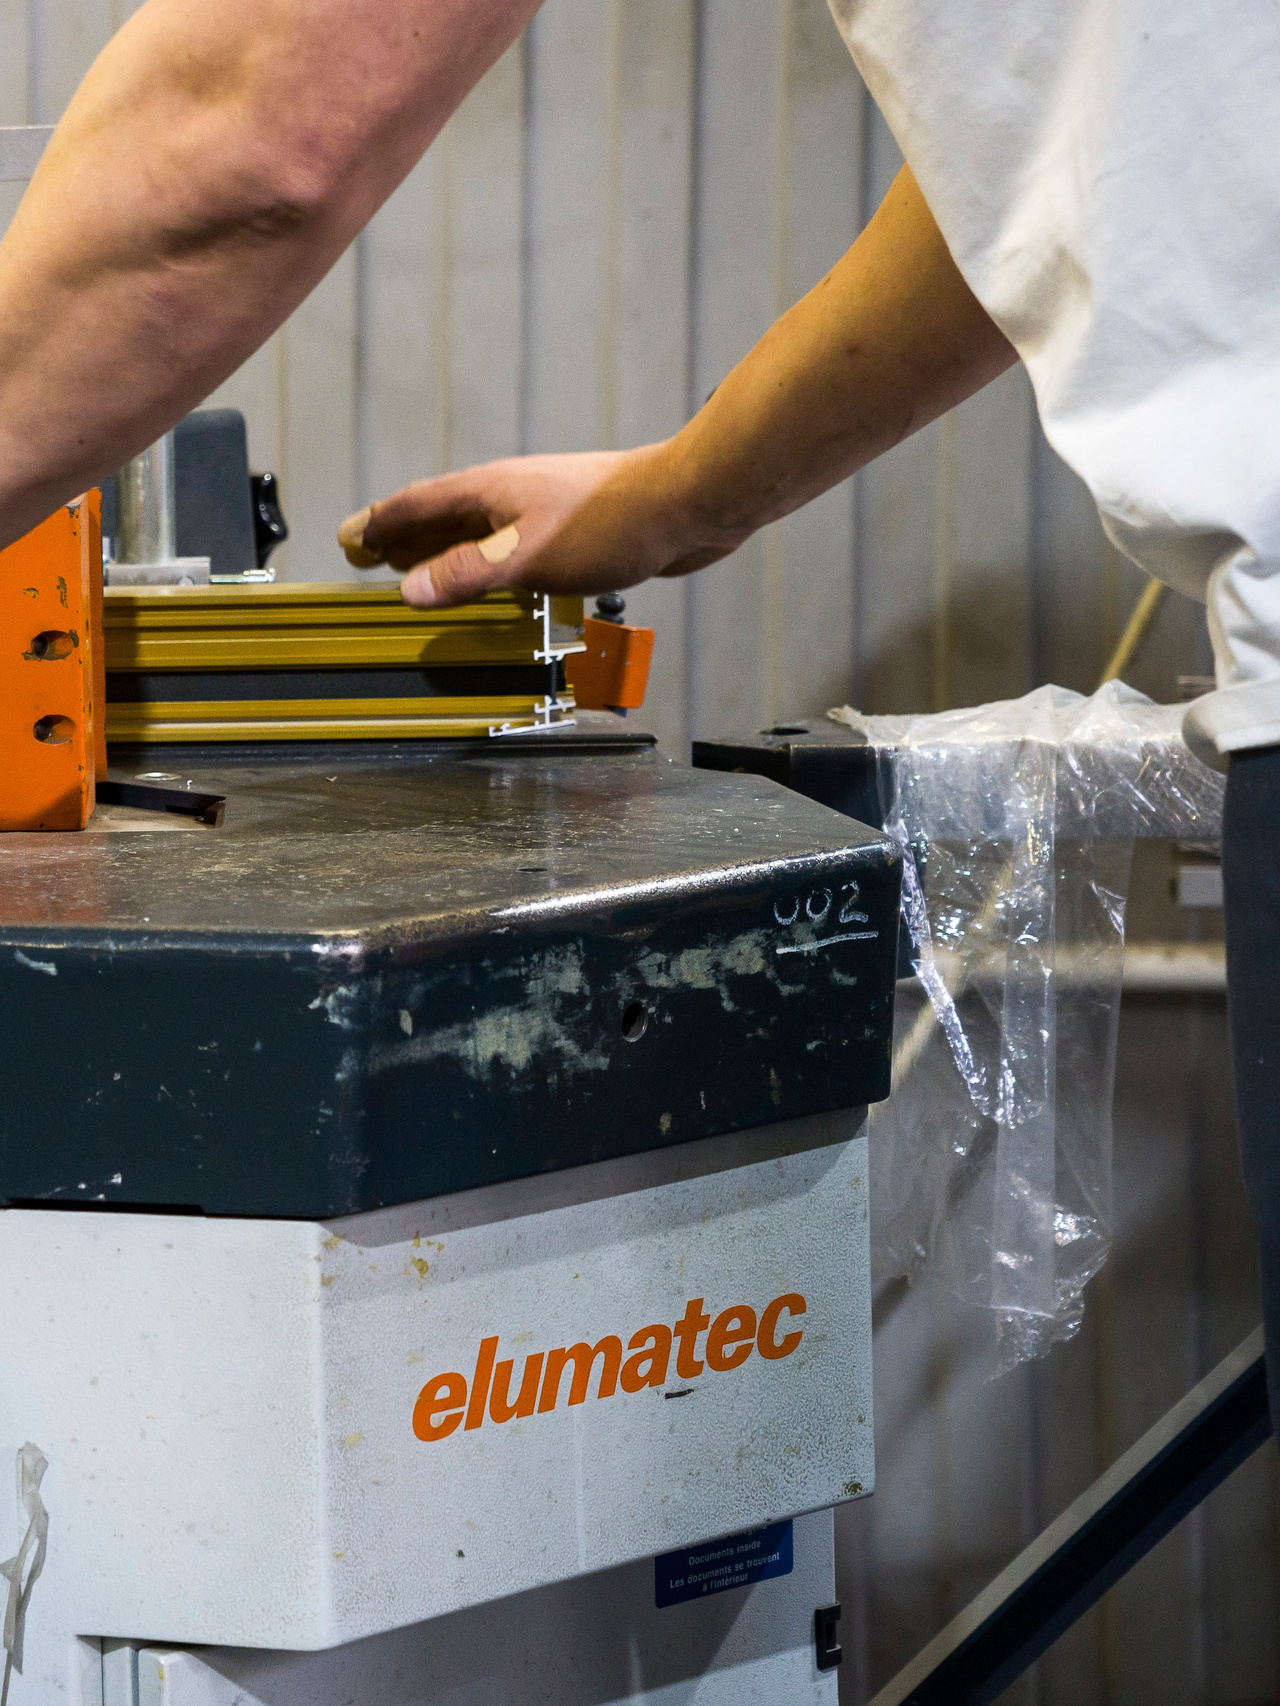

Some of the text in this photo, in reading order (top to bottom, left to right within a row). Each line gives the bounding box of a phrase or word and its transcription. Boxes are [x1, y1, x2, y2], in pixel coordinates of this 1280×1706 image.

[412, 1292, 808, 1443] elumatec
[669, 1551, 780, 1589] Les documents se trouvent
[688, 1547, 734, 1566] Documents
[736, 1540, 762, 1554] inside
